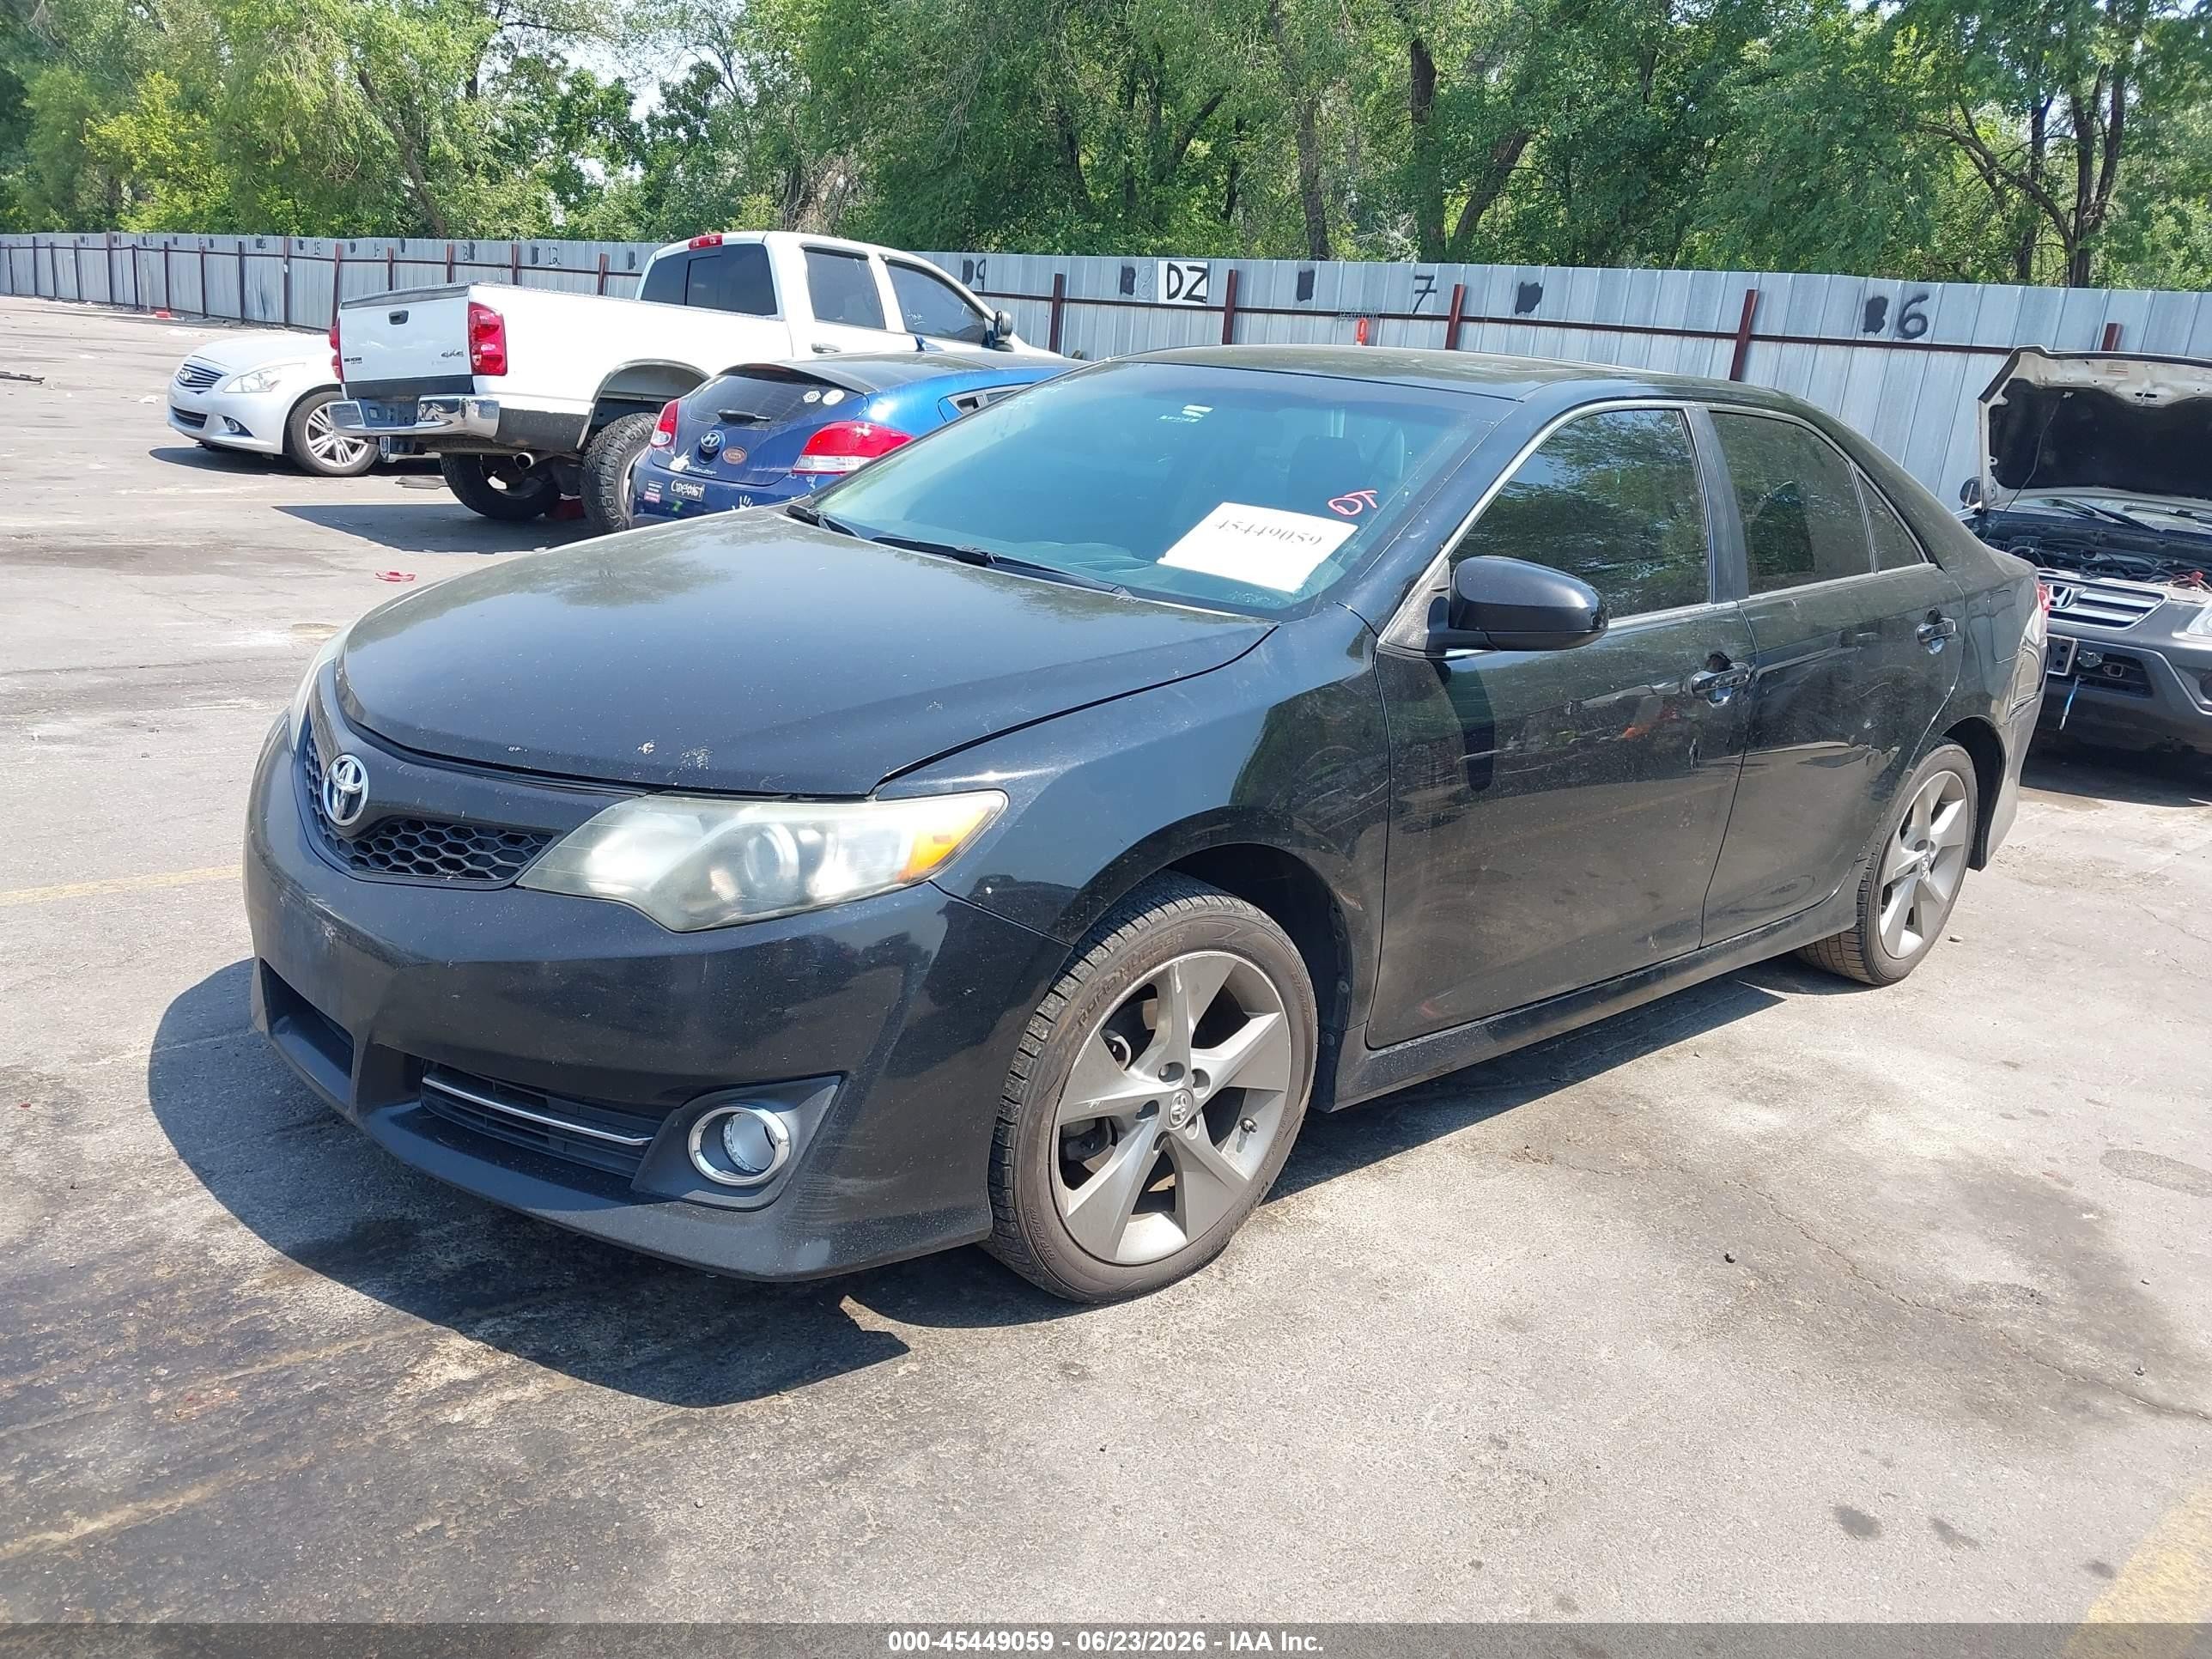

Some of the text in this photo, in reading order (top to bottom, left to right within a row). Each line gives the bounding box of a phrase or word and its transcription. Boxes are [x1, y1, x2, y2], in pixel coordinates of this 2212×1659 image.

[548, 246, 561, 264] 12
[1167, 262, 1207, 303] DZ
[1413, 275, 1437, 315] 7
[1898, 295, 1929, 339] 6
[1215, 520, 1323, 546] 45449059
